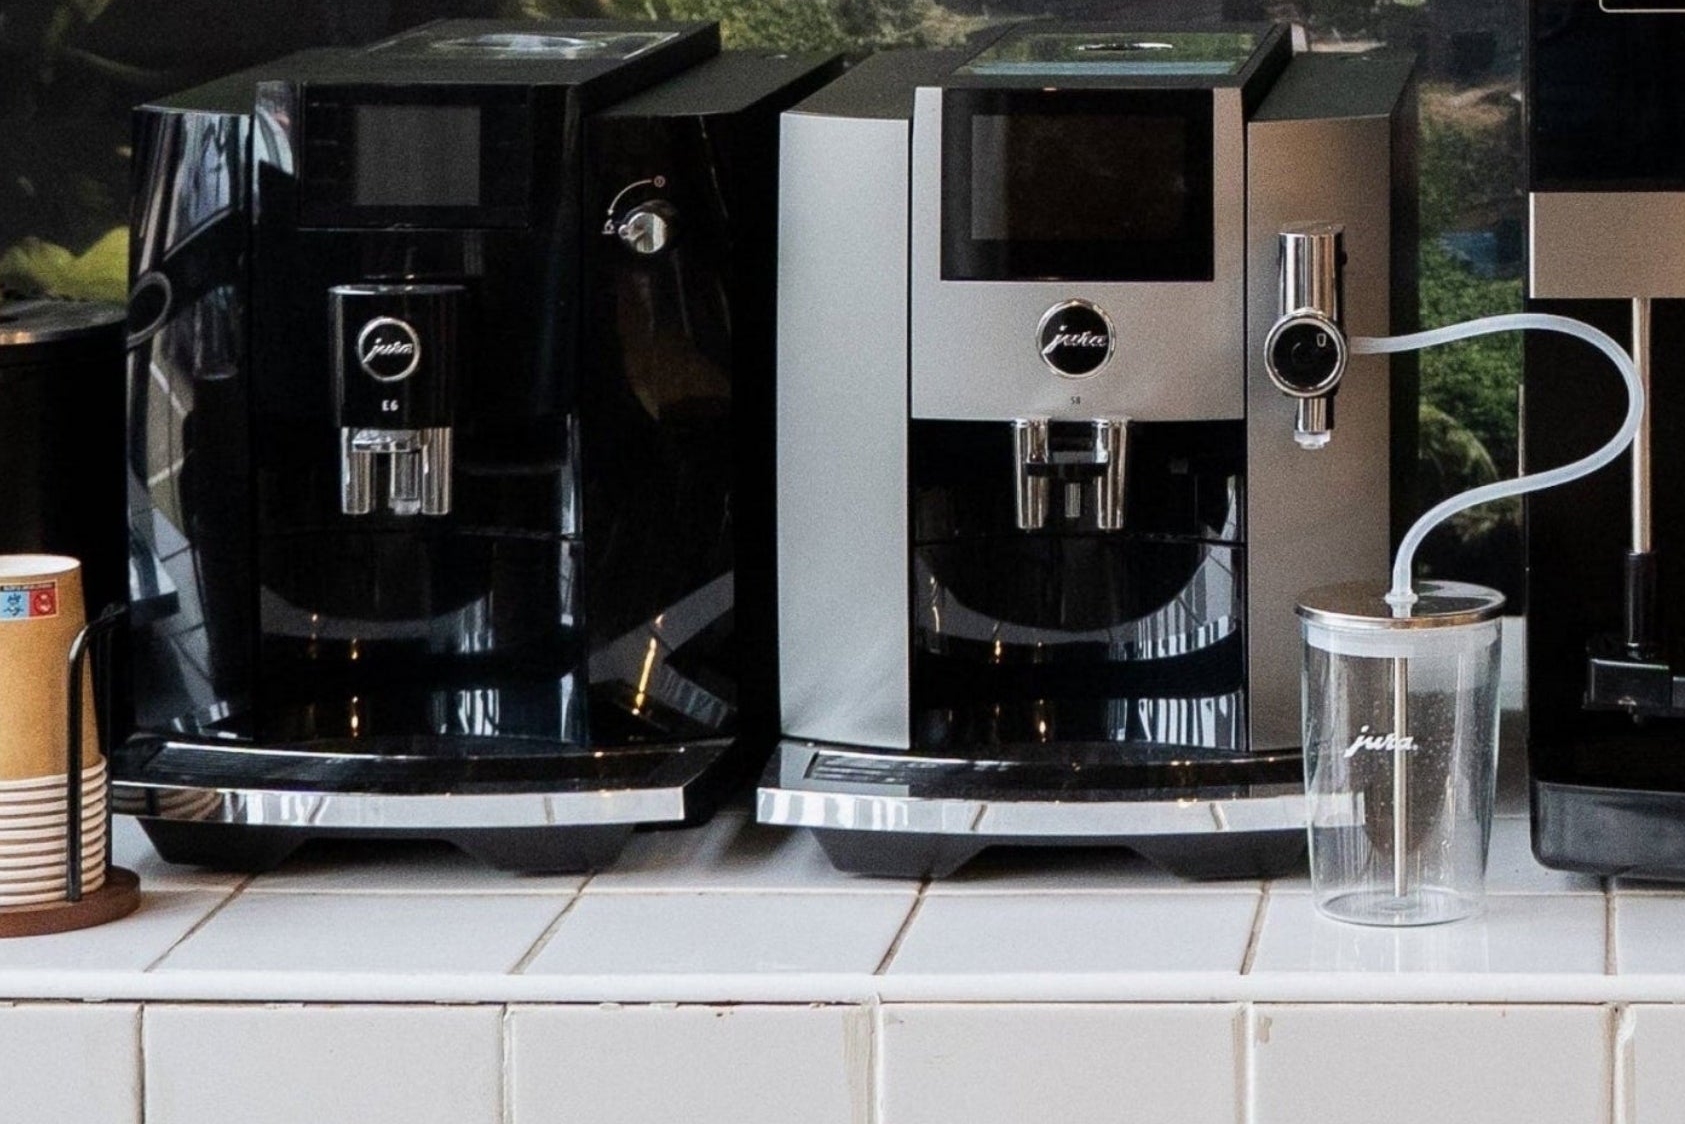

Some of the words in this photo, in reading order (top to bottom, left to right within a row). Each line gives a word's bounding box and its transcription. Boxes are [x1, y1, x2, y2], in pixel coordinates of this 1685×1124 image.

[361, 337, 414, 364] jura
[1041, 324, 1108, 354] jura
[381, 399, 400, 412] E6
[1343, 724, 1415, 758] jura
